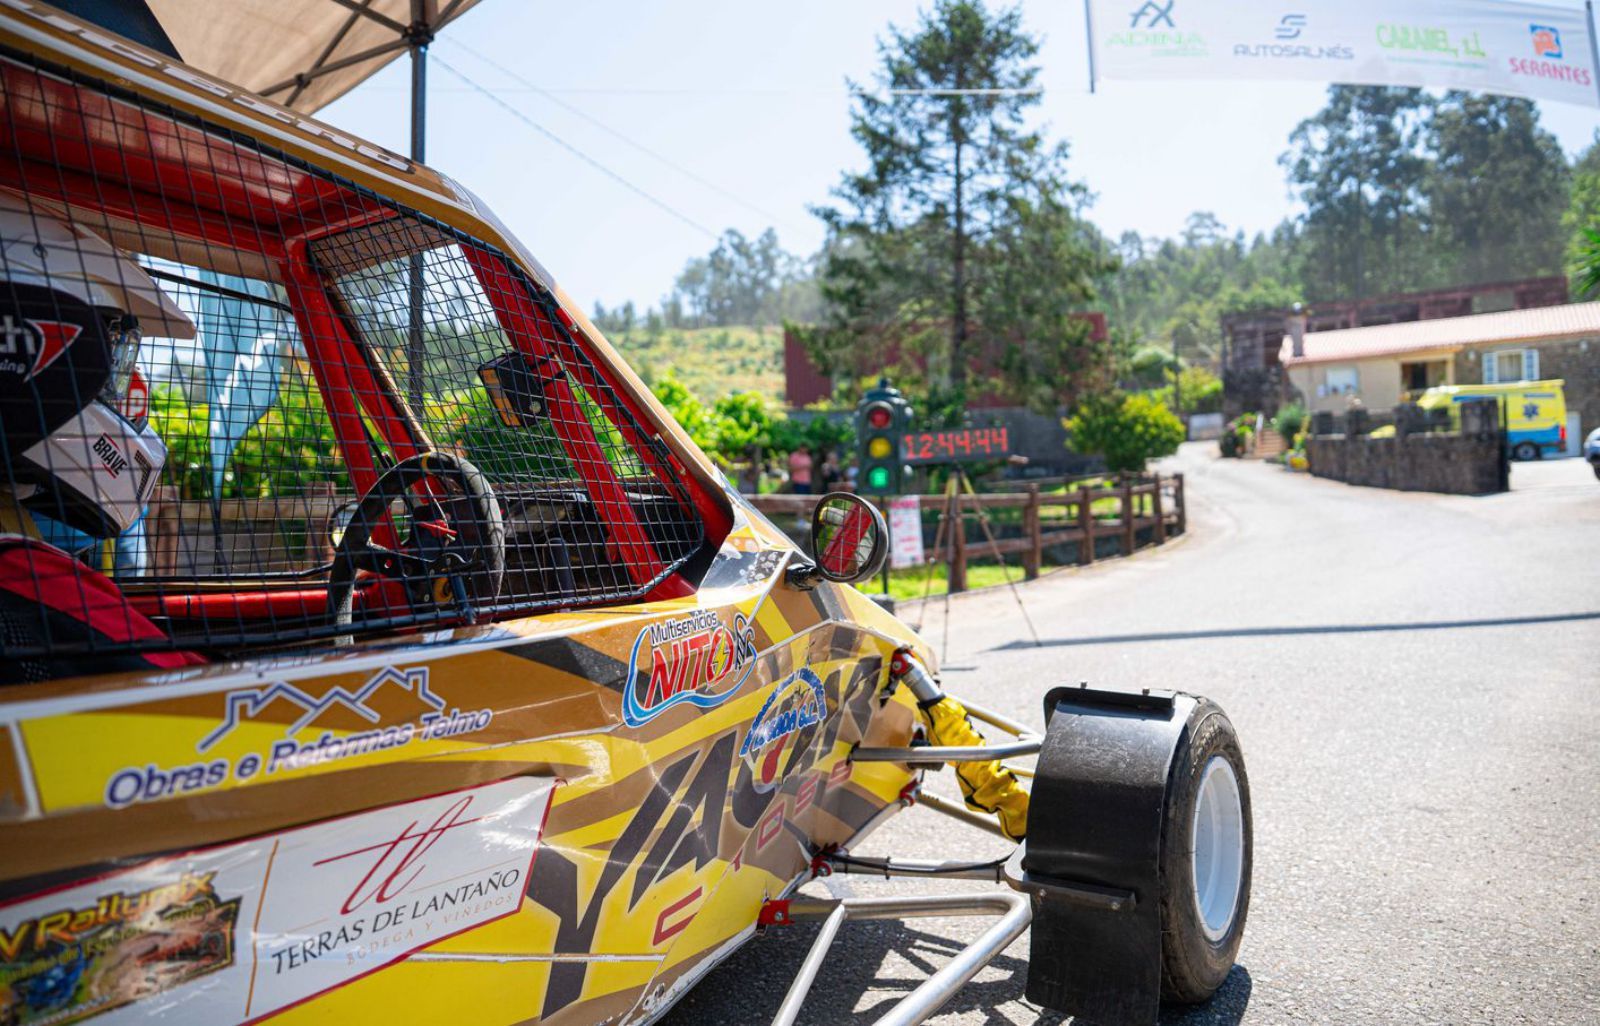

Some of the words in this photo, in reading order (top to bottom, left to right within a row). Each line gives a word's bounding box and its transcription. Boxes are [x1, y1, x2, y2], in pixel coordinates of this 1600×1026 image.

[1233, 42, 1355, 61] AUTOSALNÉS
[1508, 57, 1592, 87] SERANTES
[93, 435, 128, 476] BRAVE
[649, 611, 718, 646] Multiservicios
[643, 624, 735, 709] NITO
[106, 761, 227, 808] Obras
[237, 755, 261, 780] e
[268, 723, 415, 773] Reformas
[420, 708, 492, 740] Telmo
[271, 919, 365, 975] TERRAS
[371, 904, 403, 934] DE
[411, 868, 520, 920] LANTAÑO
[345, 928, 415, 965] BODEGA
[424, 920, 434, 932] Y
[443, 892, 515, 924] VIÑEDOS
